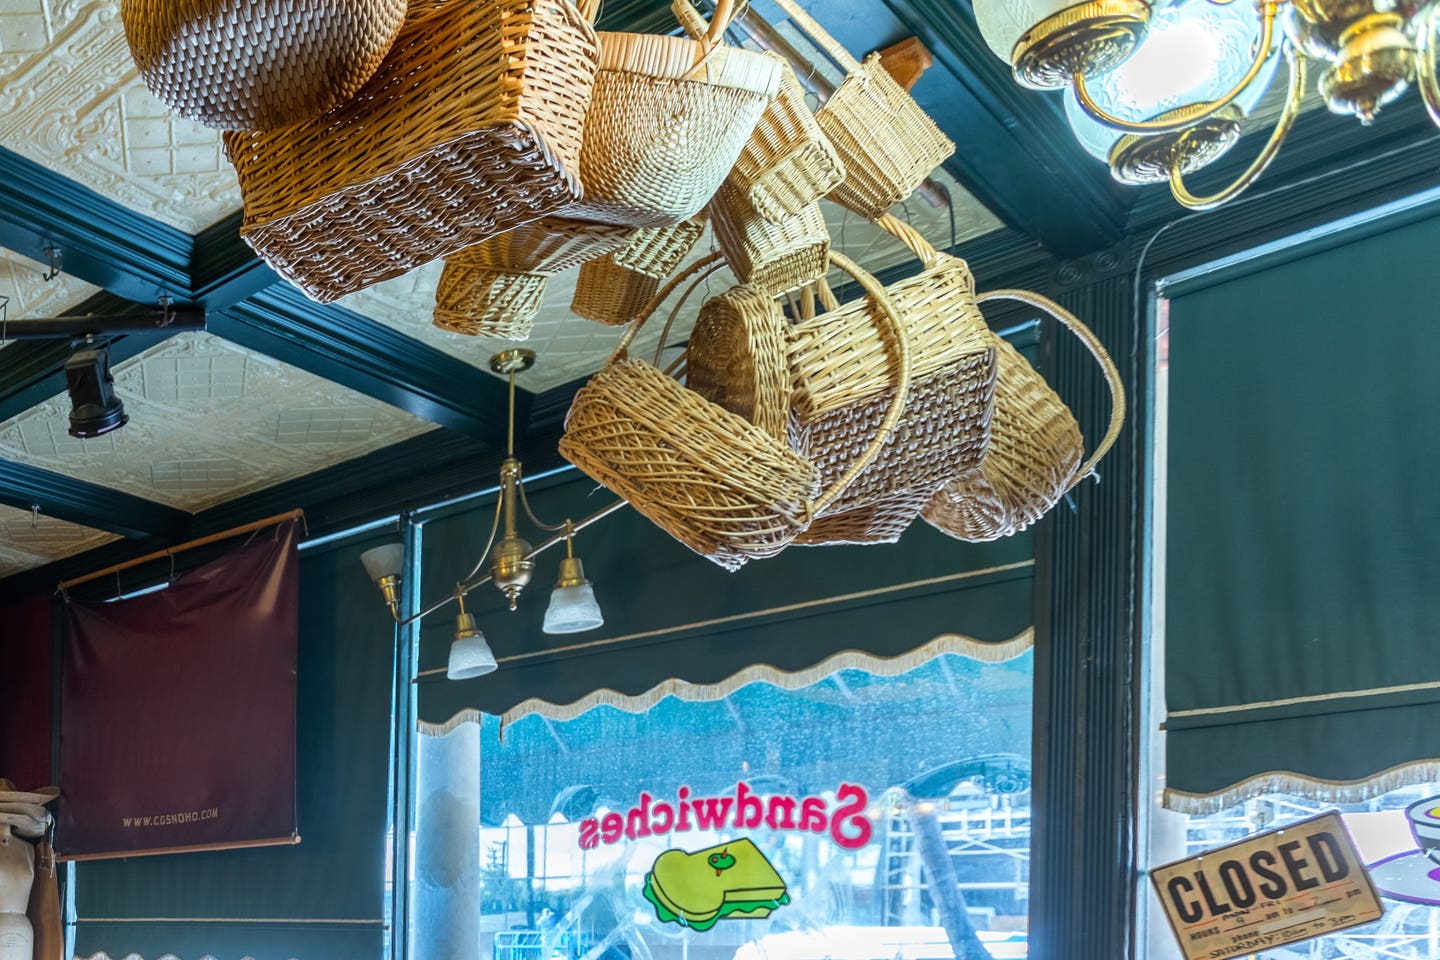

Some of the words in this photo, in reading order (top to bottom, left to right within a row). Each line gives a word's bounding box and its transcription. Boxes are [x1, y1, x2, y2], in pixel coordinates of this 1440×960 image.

[1168, 831, 1349, 924] CLOSED
[1188, 926, 1221, 941] HOURS
[1231, 930, 1260, 943] phone
